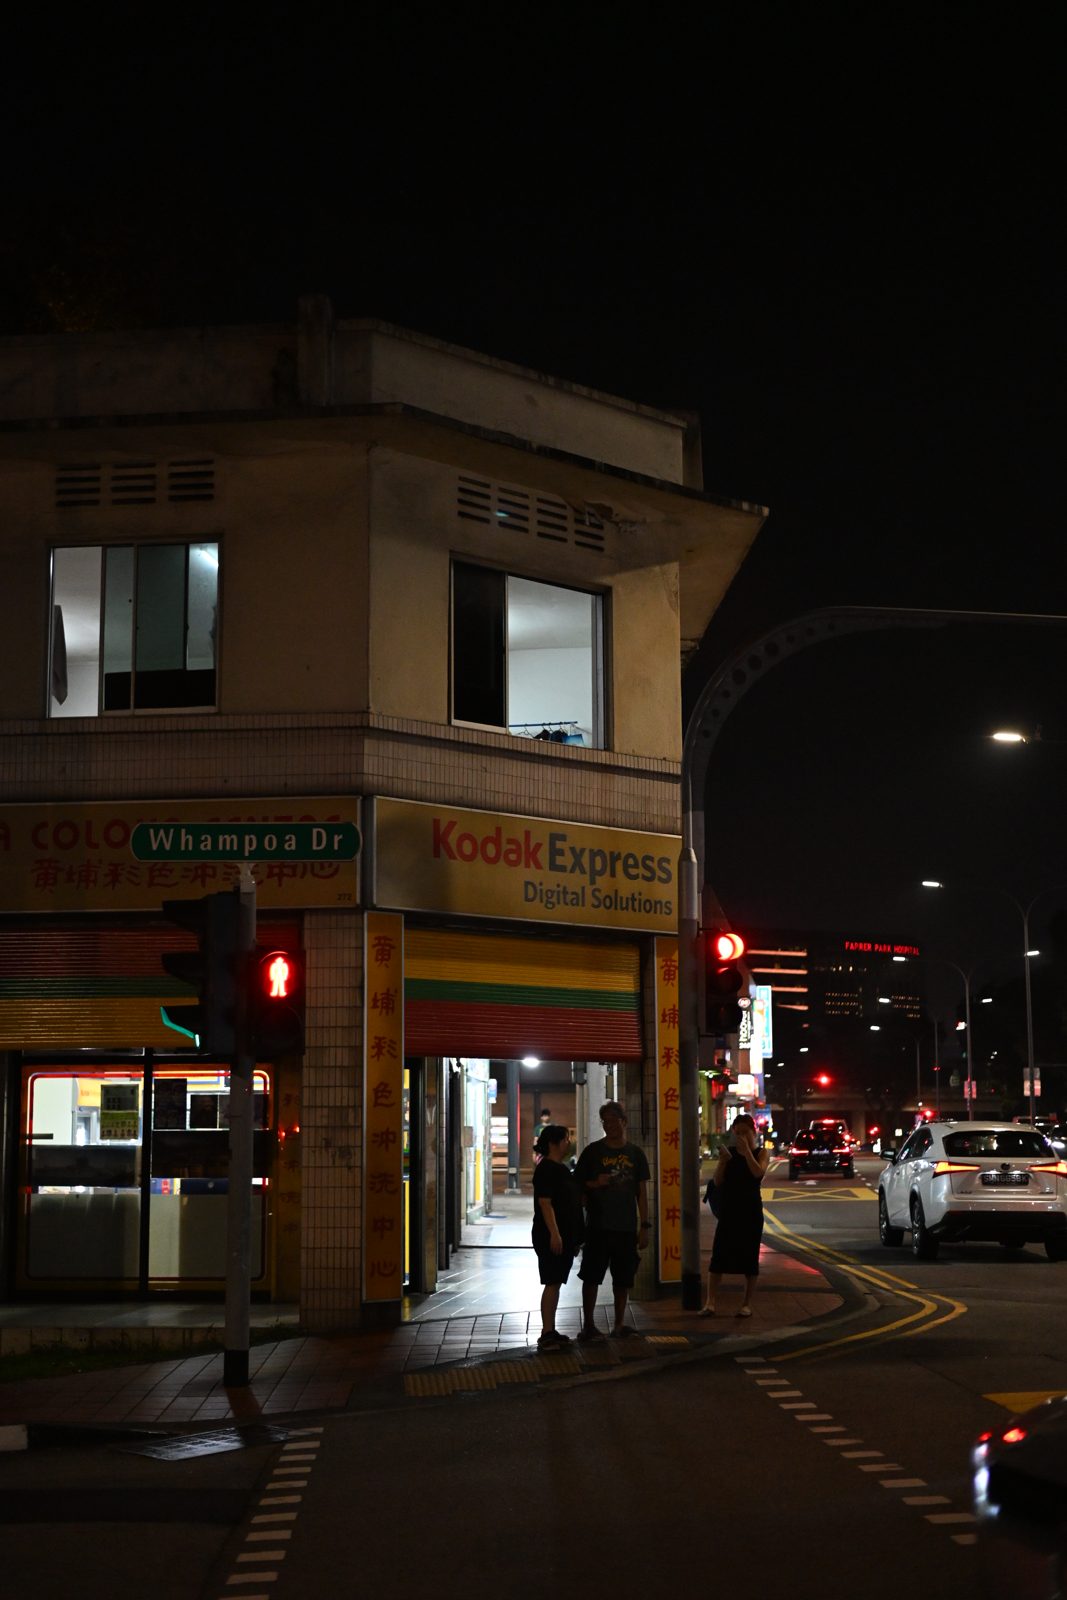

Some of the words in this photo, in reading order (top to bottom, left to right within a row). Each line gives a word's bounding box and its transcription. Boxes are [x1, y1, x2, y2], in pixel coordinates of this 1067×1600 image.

[149, 828, 297, 856] Whampoa
[312, 828, 344, 851] Dr
[433, 818, 543, 870] Kodak
[549, 833, 672, 884] Express
[523, 880, 586, 909] Digital
[591, 888, 673, 915] Solutions
